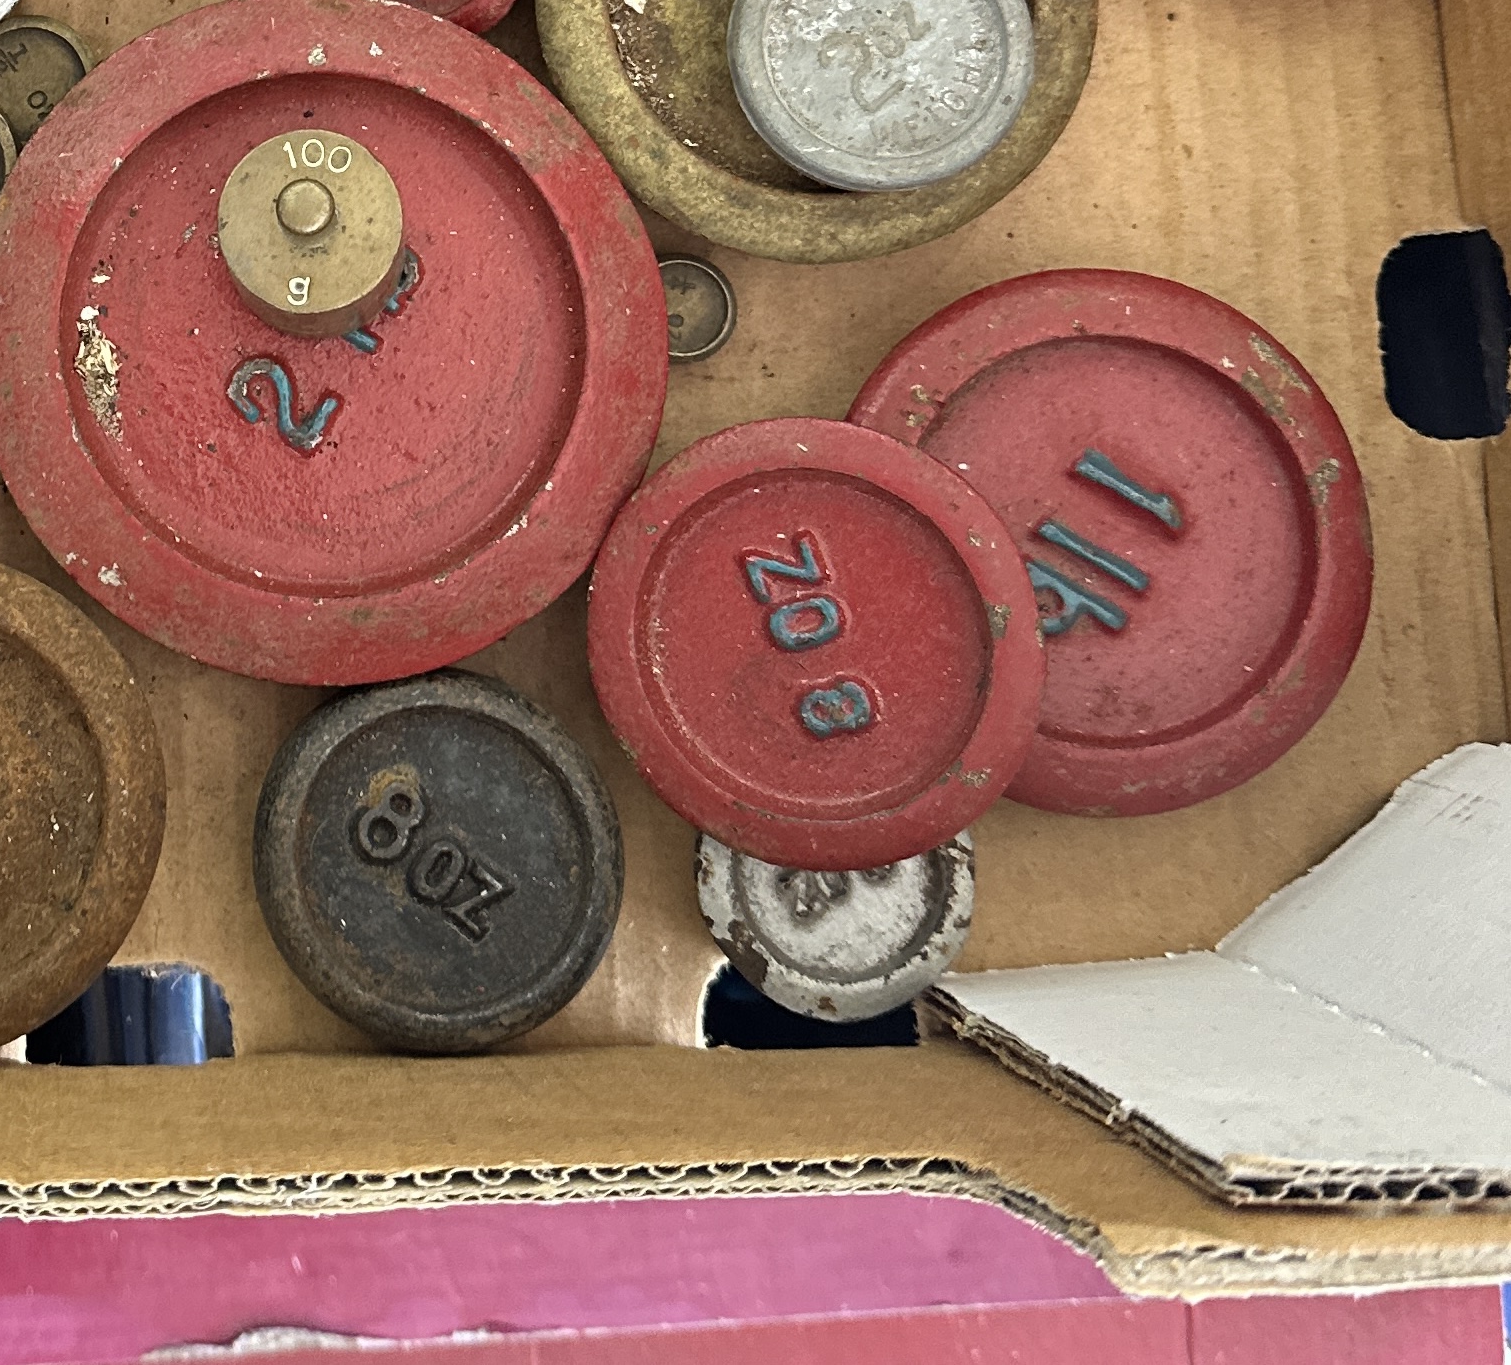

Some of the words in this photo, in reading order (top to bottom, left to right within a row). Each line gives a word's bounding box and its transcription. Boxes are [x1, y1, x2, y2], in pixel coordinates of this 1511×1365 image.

[283, 138, 352, 173] 100
[286, 276, 311, 305] g
[226, 357, 339, 449] 2
[800, 681, 872, 738] 8
